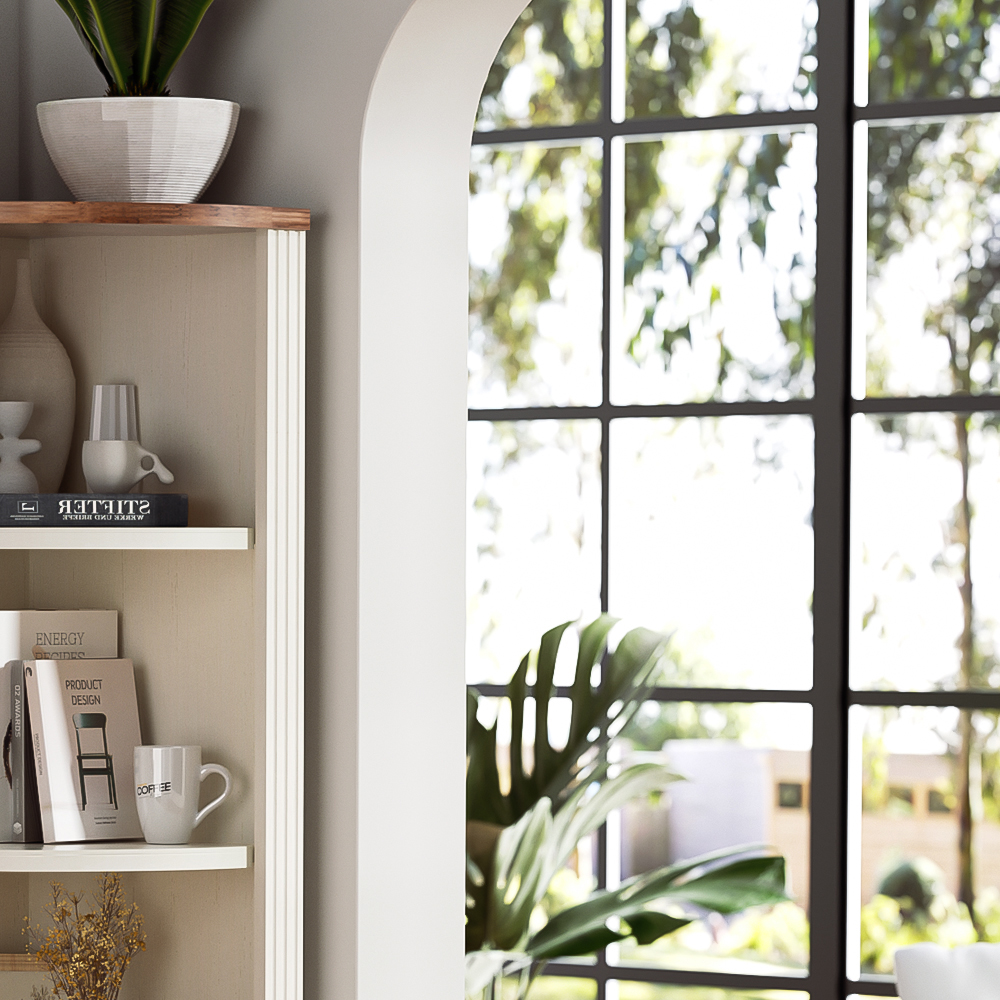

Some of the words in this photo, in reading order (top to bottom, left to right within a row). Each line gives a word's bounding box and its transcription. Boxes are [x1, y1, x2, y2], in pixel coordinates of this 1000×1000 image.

[36, 632, 85, 646] ENERGY
[14, 684, 21, 696] 02
[65, 679, 103, 691] PRODUCT
[71, 695, 101, 706] DESIGN
[14, 698, 22, 738] AWARDS
